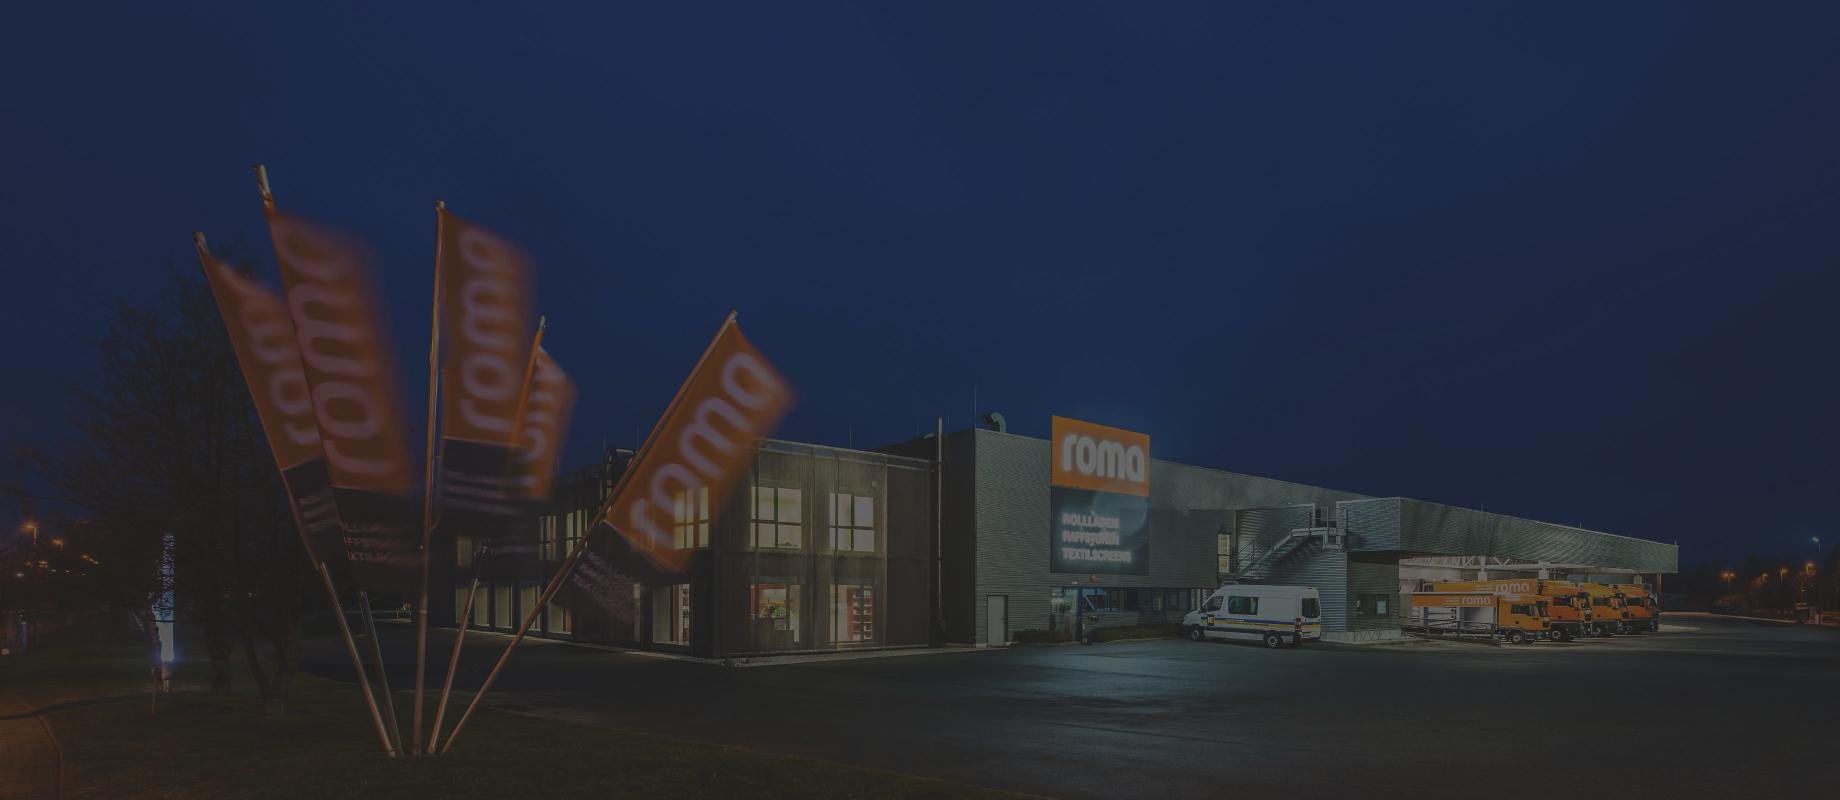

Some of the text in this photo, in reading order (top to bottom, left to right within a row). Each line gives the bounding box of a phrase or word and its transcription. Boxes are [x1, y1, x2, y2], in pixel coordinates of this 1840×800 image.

[456, 226, 520, 433] roma
[627, 351, 780, 545] roma
[1063, 434, 1145, 482] roma
[1062, 547, 1132, 562] TEXTILSCREENS
[1462, 596, 1491, 605] roma
[1495, 581, 1530, 593] roma
